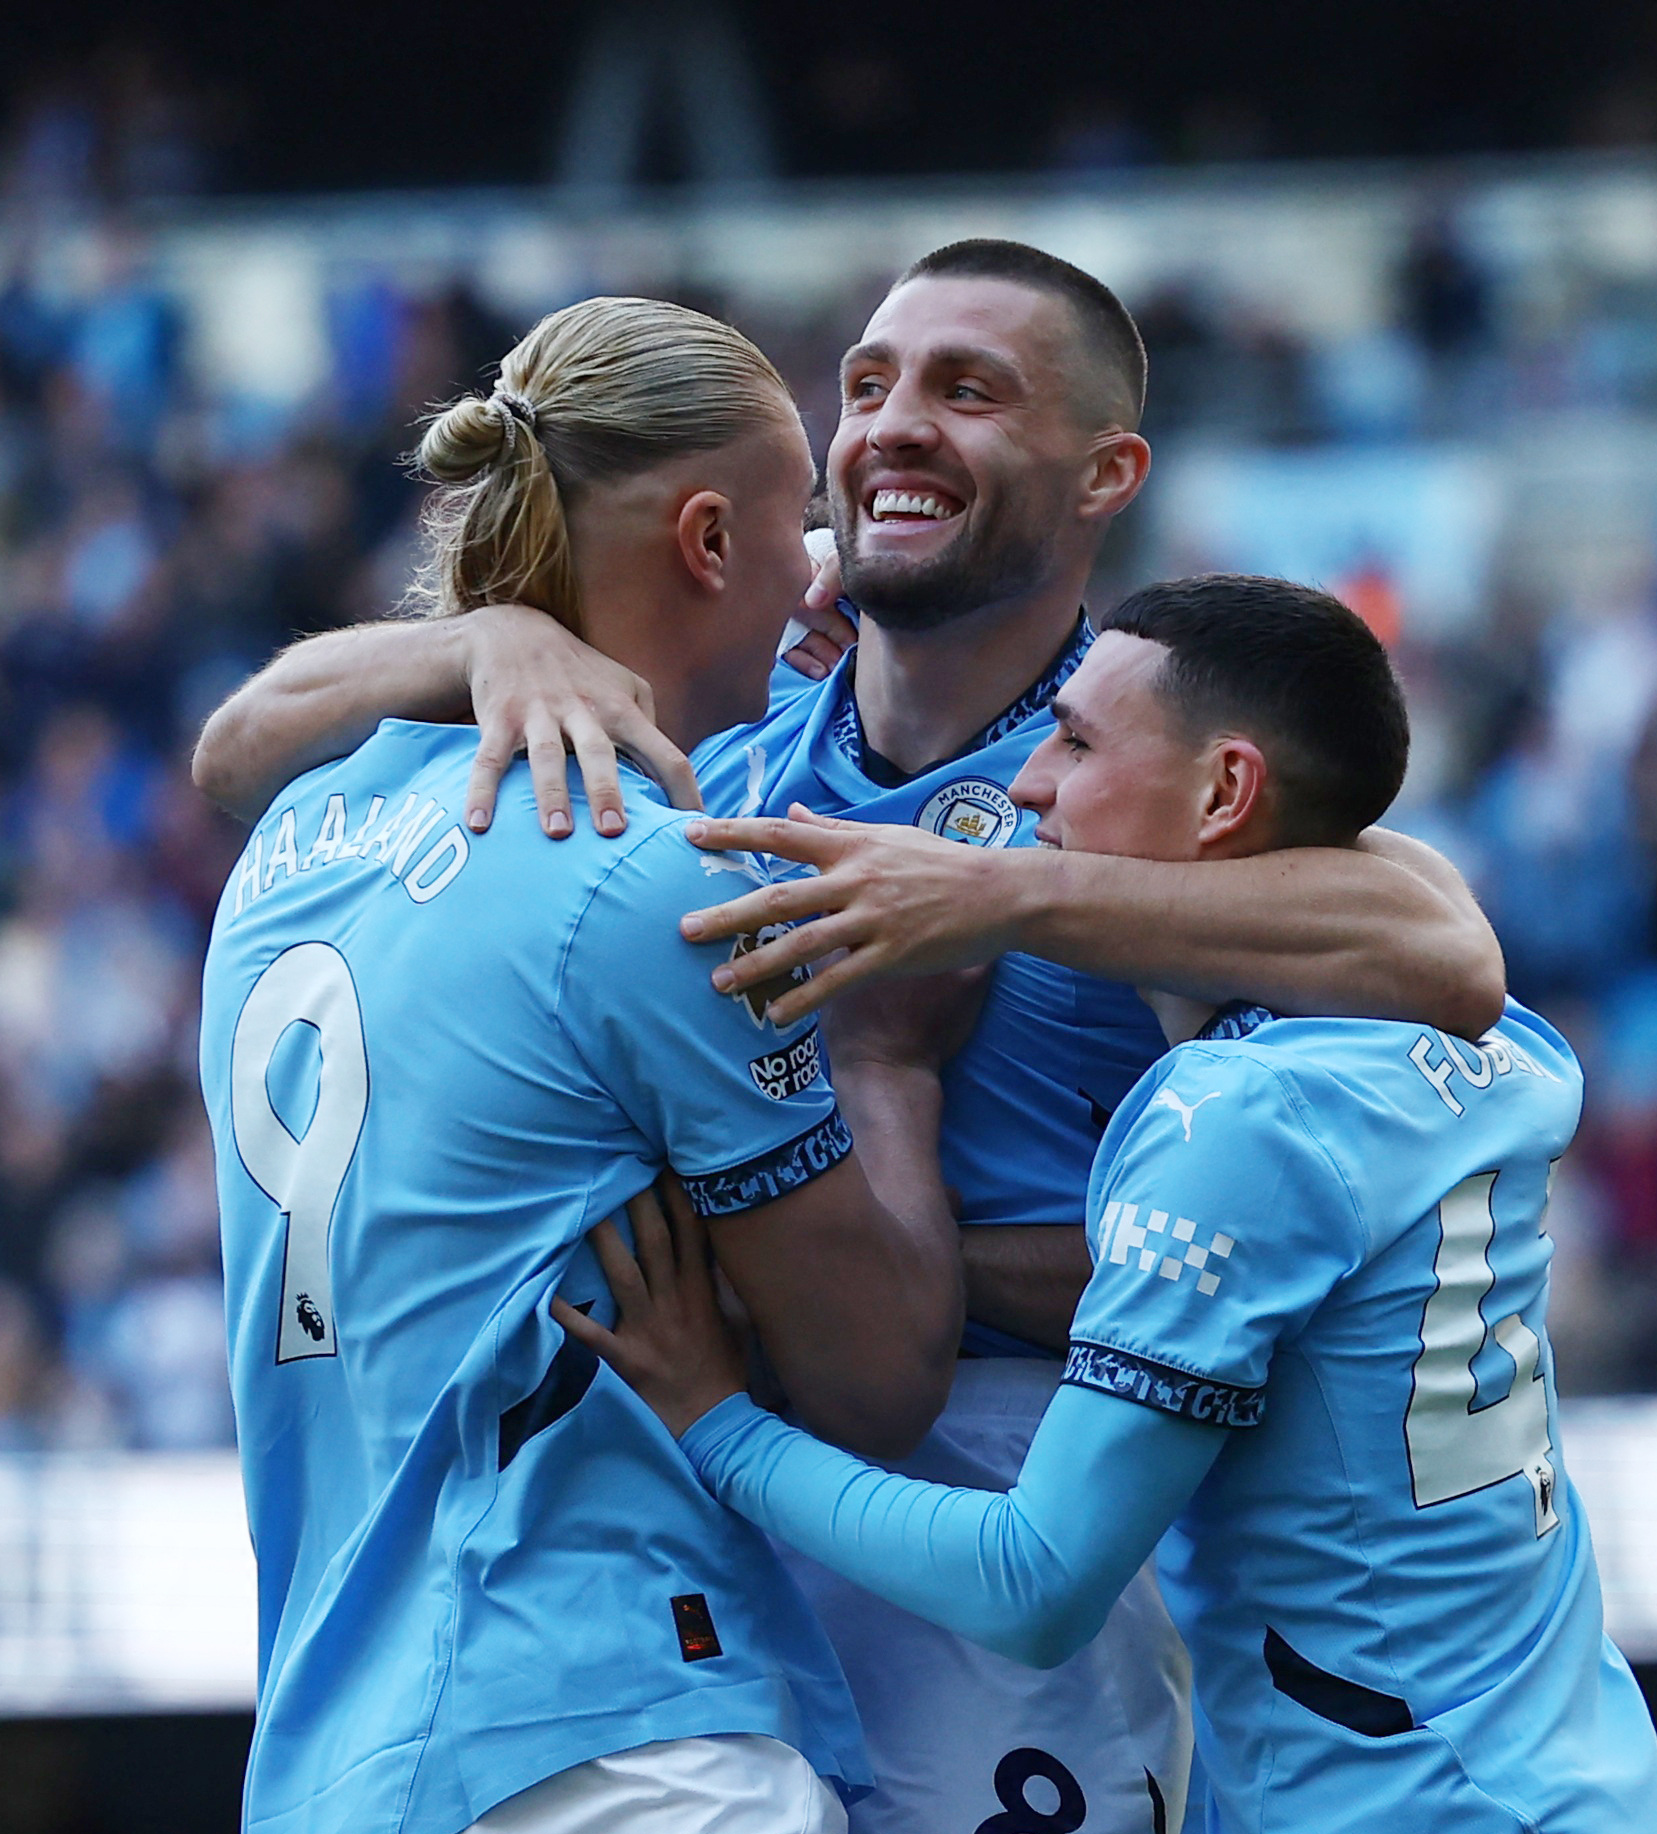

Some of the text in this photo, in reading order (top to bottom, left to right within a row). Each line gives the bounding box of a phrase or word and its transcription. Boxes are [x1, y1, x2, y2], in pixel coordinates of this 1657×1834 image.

[233, 791, 471, 918] HAALAND
[937, 784, 1014, 828] MANCHESTER
[749, 1056, 787, 1086] No
[230, 940, 370, 1366] 9
[1404, 1160, 1561, 1540] 4
